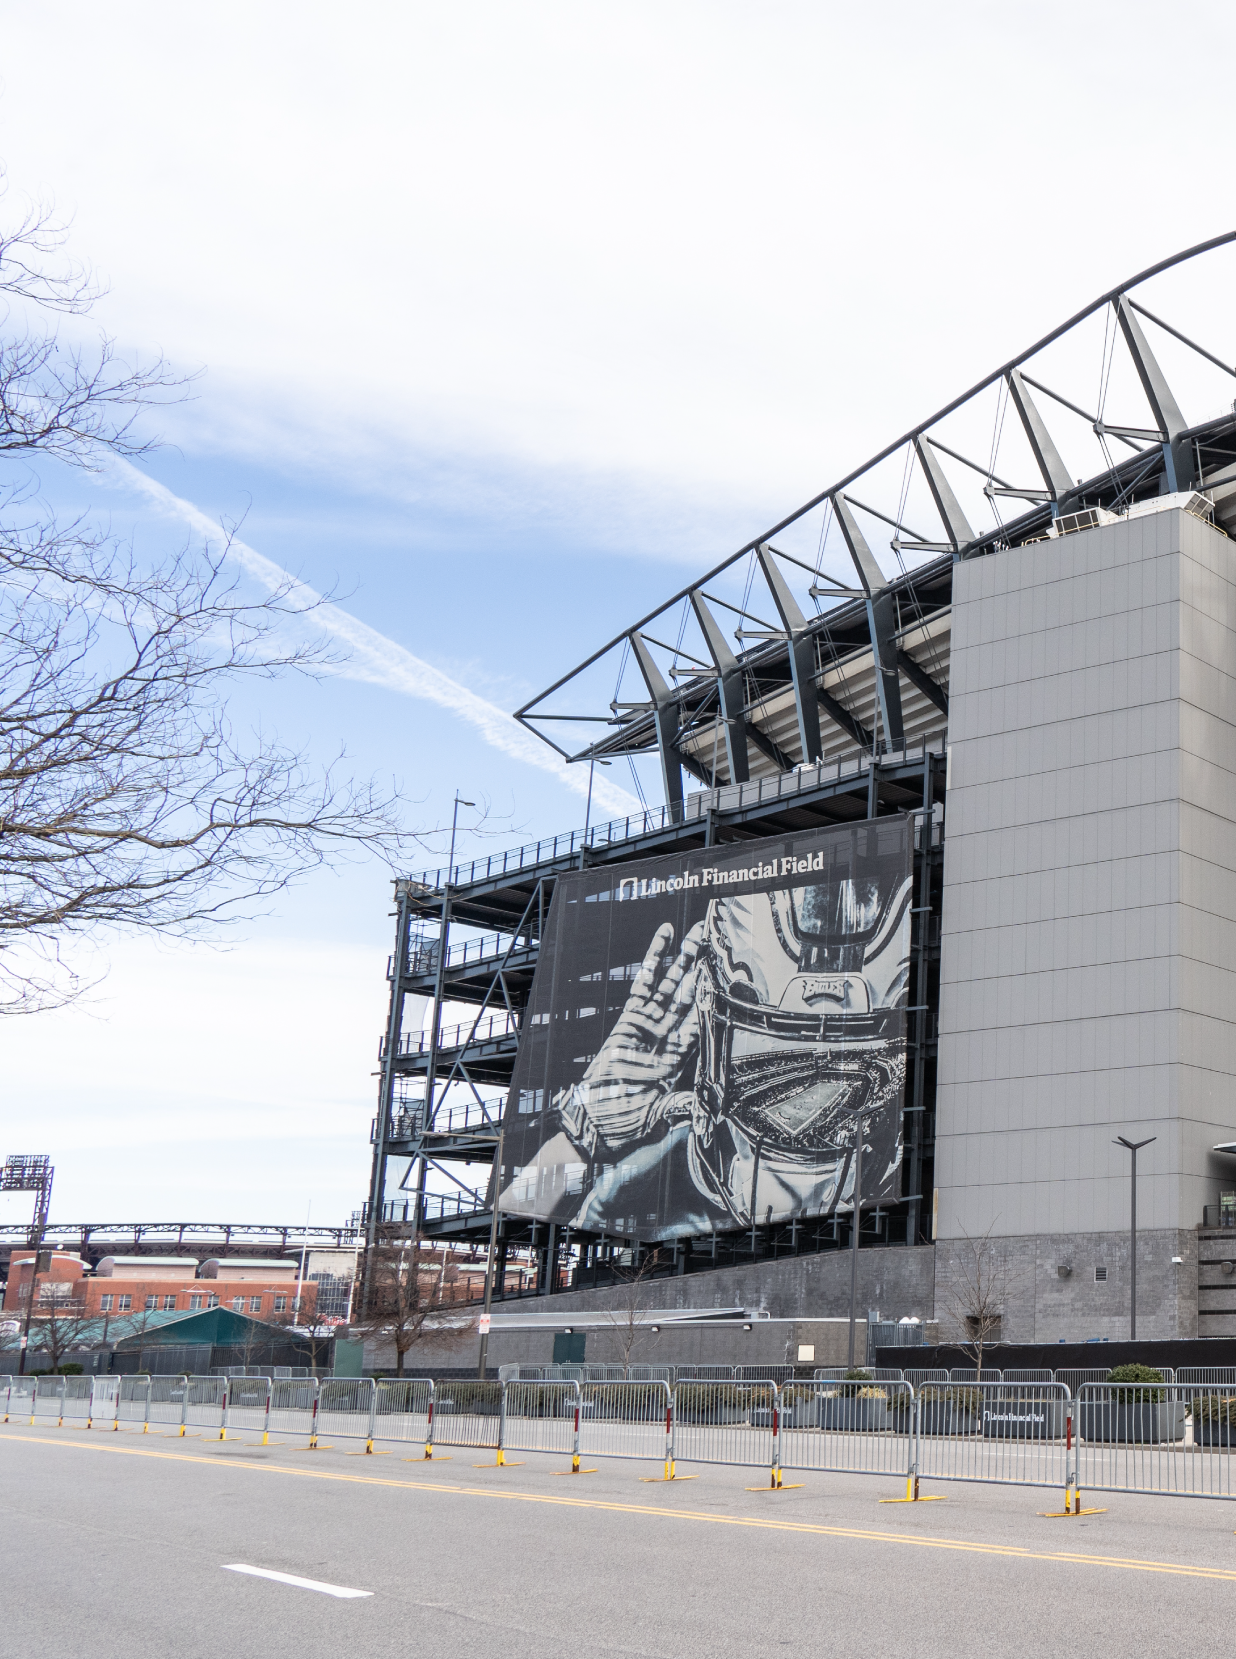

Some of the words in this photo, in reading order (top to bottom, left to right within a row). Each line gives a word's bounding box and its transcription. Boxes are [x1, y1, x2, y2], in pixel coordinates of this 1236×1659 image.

[641, 870, 699, 896] Lincoln
[701, 858, 778, 886] Financial
[780, 851, 824, 876] Field
